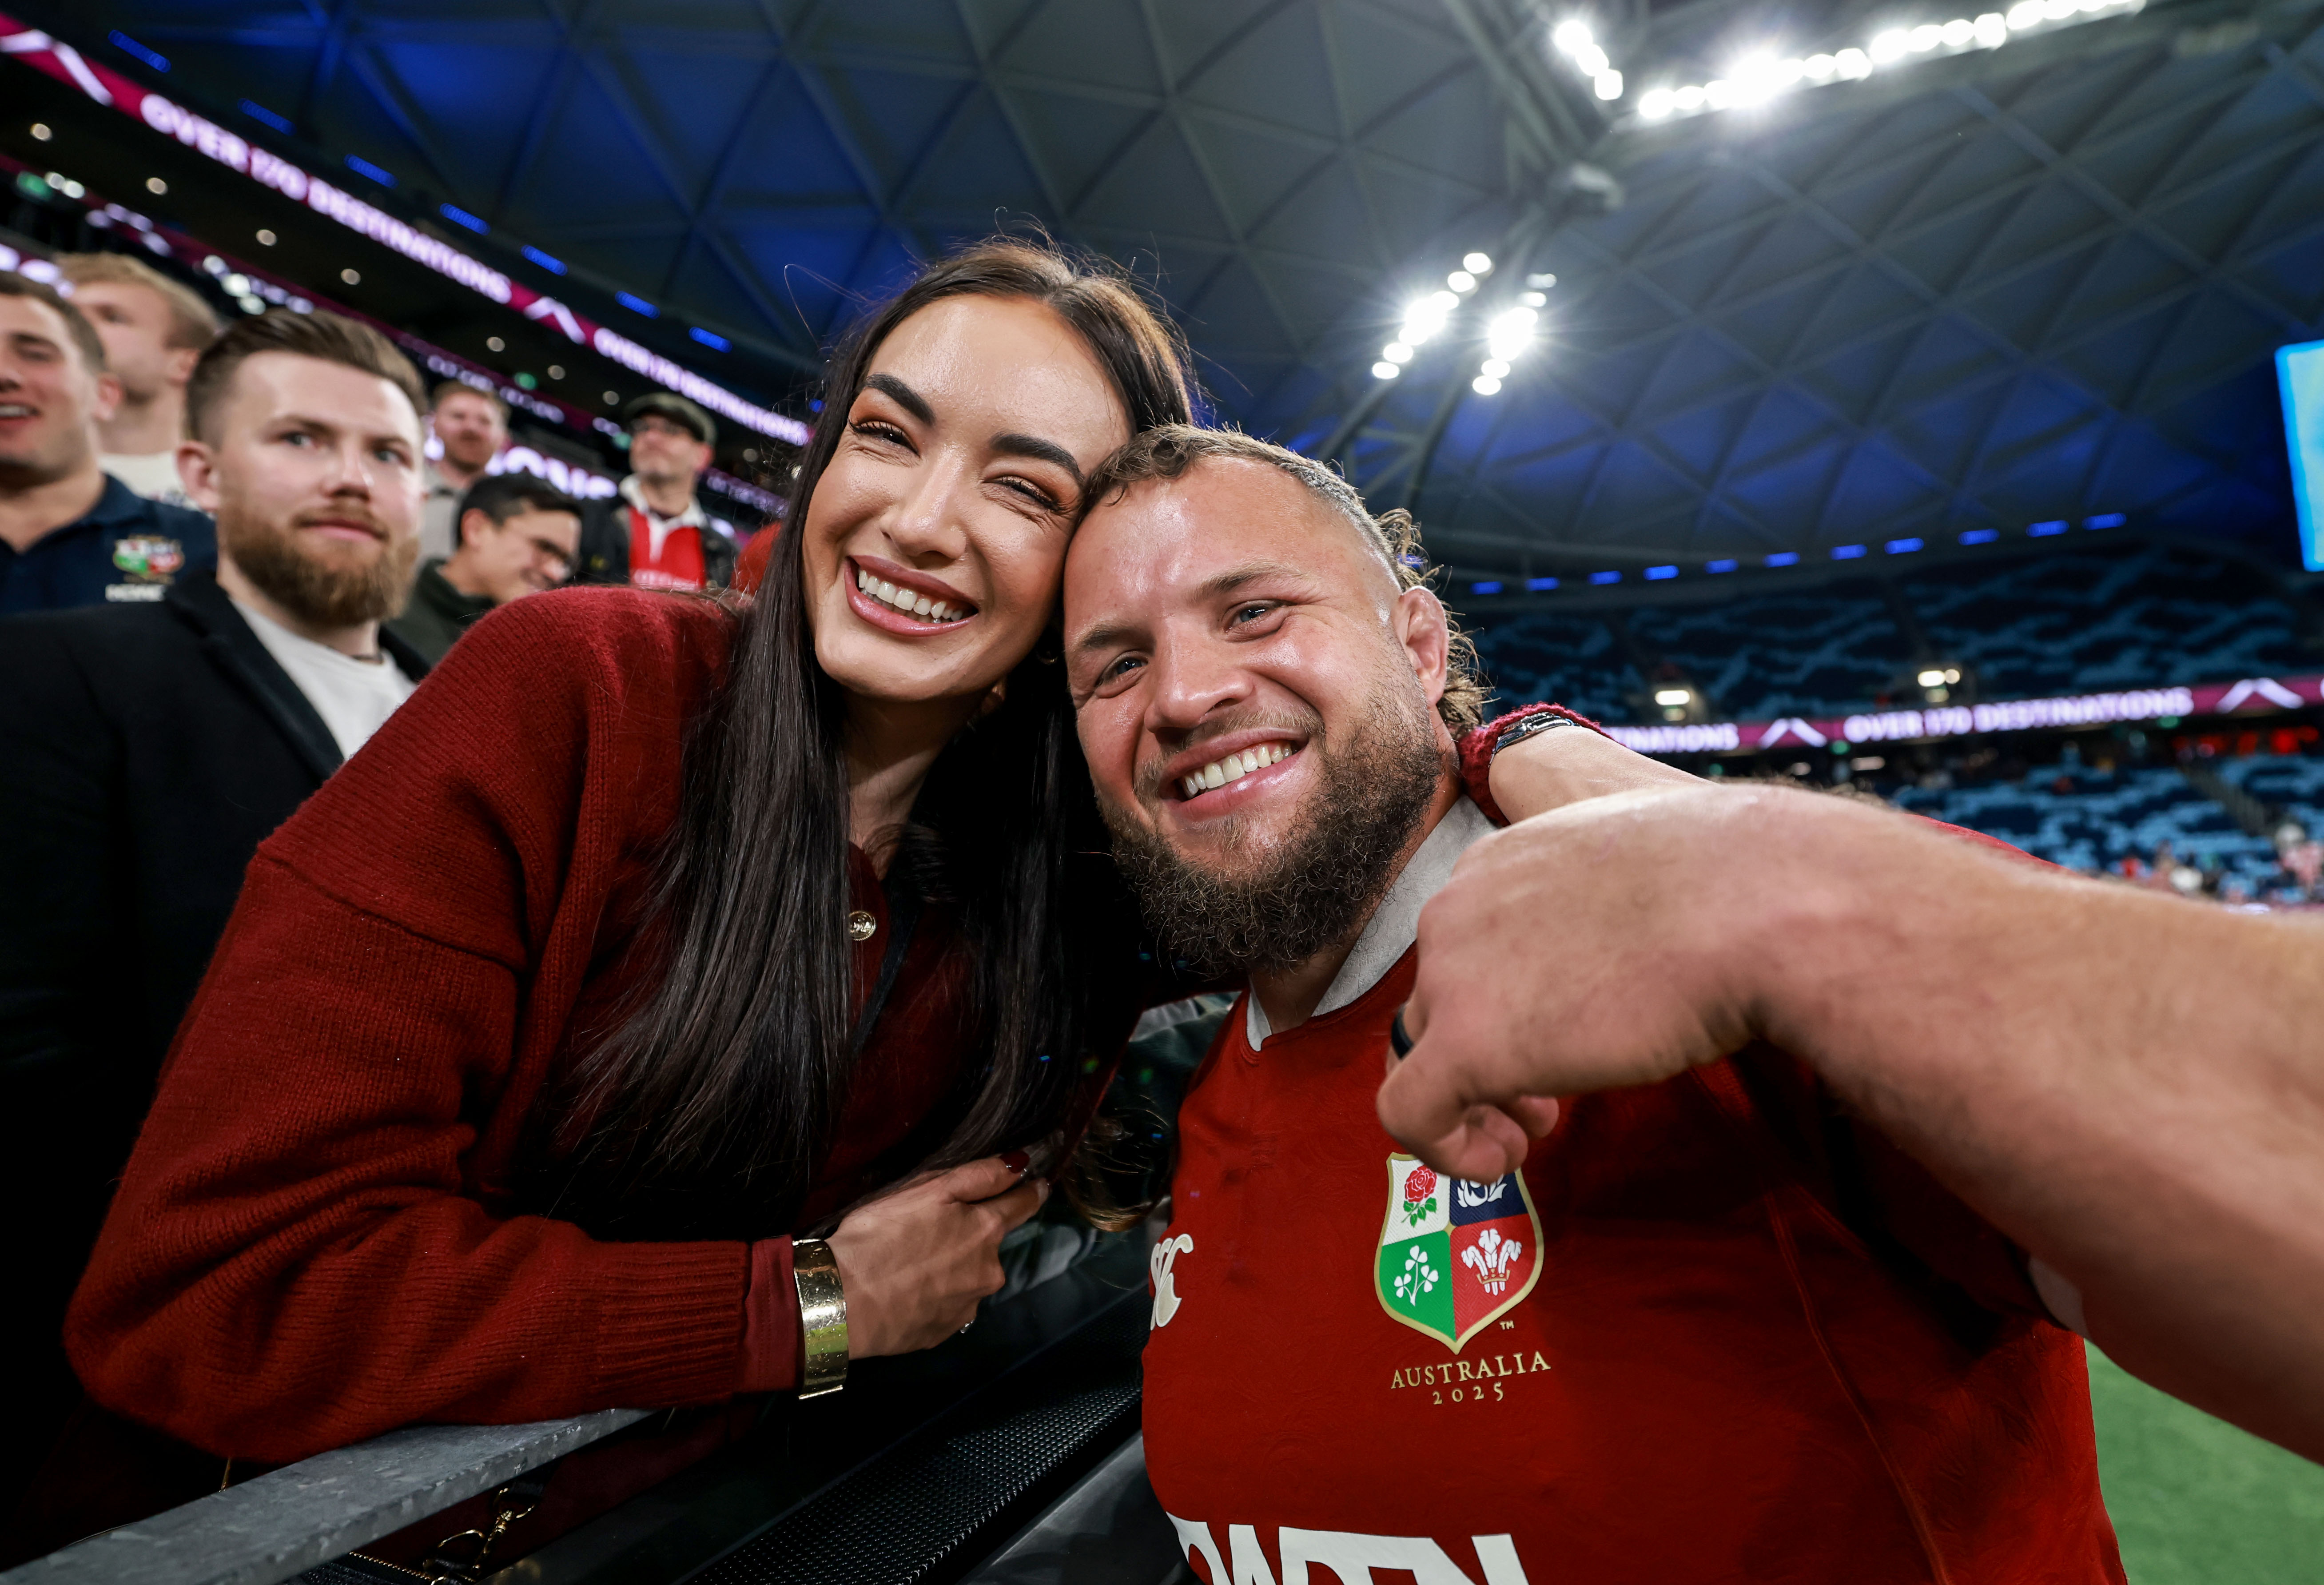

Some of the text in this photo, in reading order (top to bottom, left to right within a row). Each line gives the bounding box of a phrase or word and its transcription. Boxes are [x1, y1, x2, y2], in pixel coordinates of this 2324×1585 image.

[140, 94, 249, 173] OVER
[1844, 710, 1923, 743] OVER
[1390, 1351, 1551, 1389] AUSTRALIA
[1433, 1382, 1504, 1405] 2025
